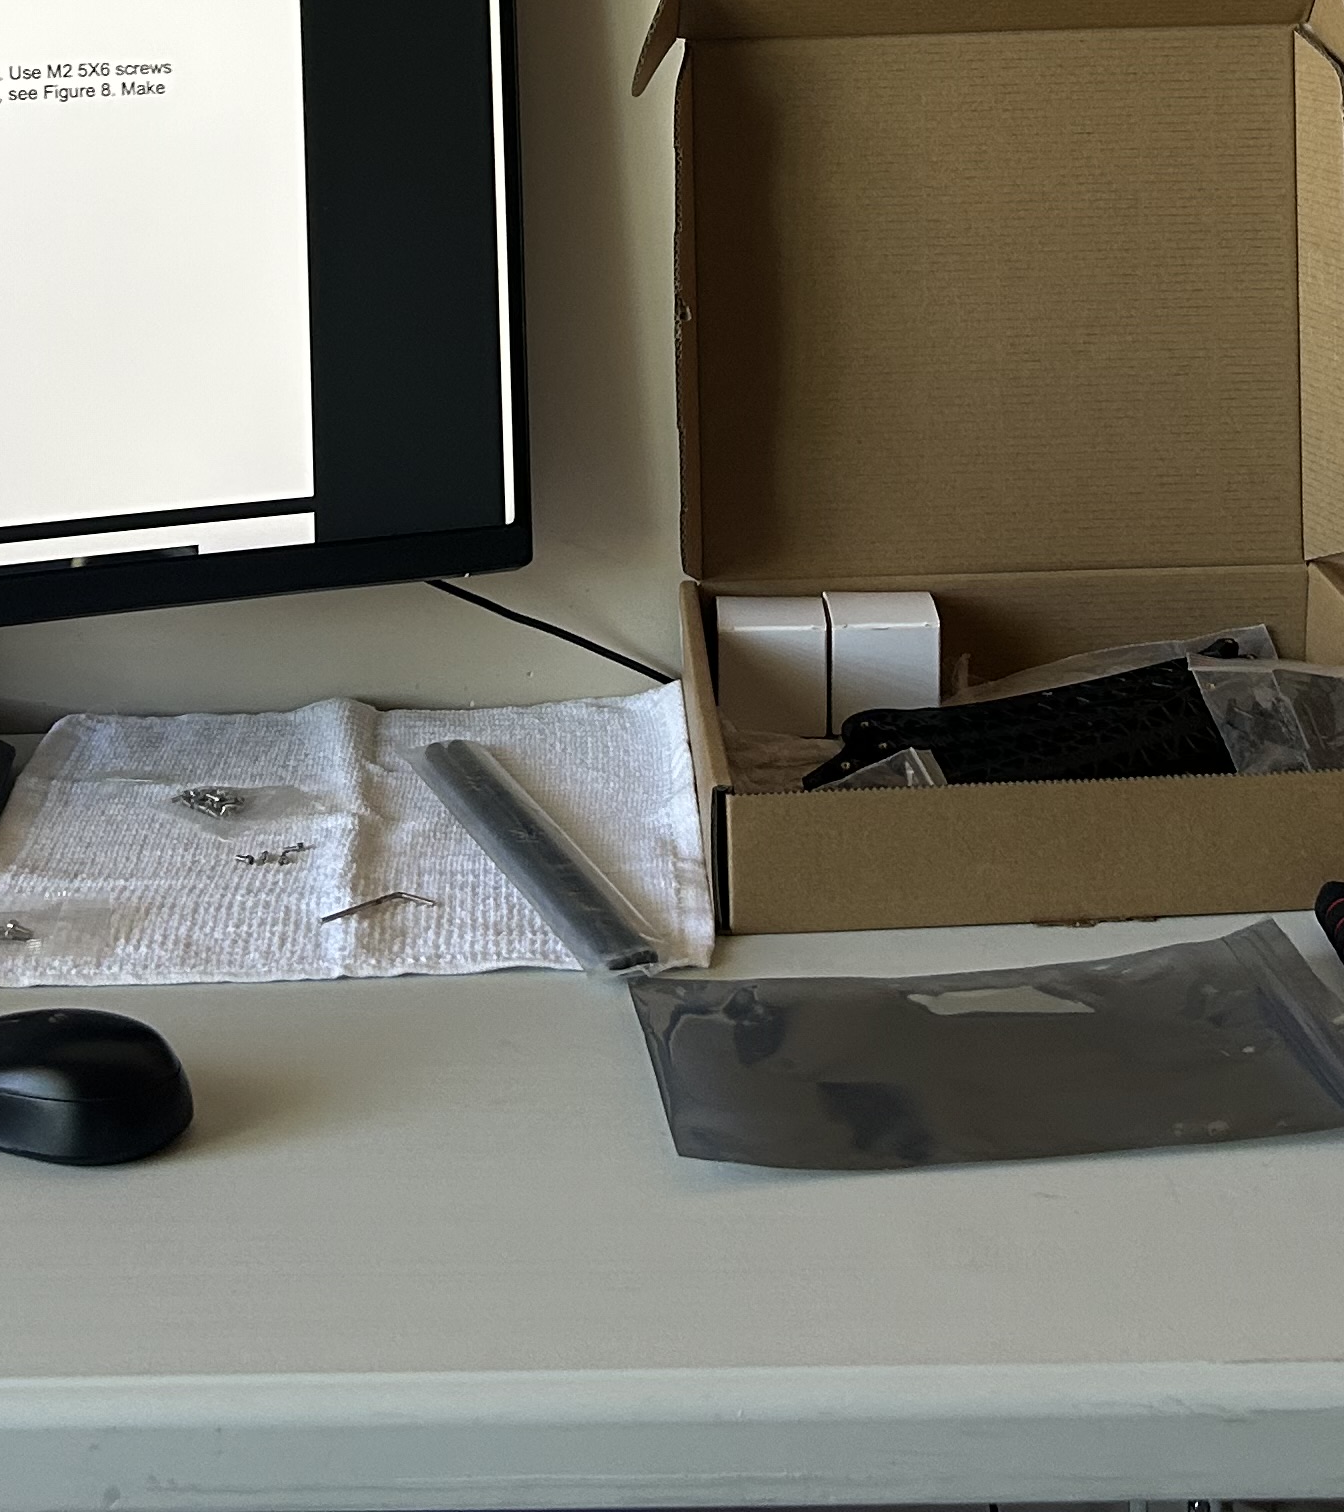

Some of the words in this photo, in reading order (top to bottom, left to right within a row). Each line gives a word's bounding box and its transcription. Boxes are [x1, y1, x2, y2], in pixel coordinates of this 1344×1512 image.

[9, 66, 41, 80] Use
[47, 64, 72, 78] M2
[78, 63, 110, 77] 5X6
[116, 63, 171, 75] screws
[9, 89, 37, 100] see
[44, 85, 95, 102] Figure
[101, 83, 115, 96] 8.
[122, 81, 165, 95] Make
